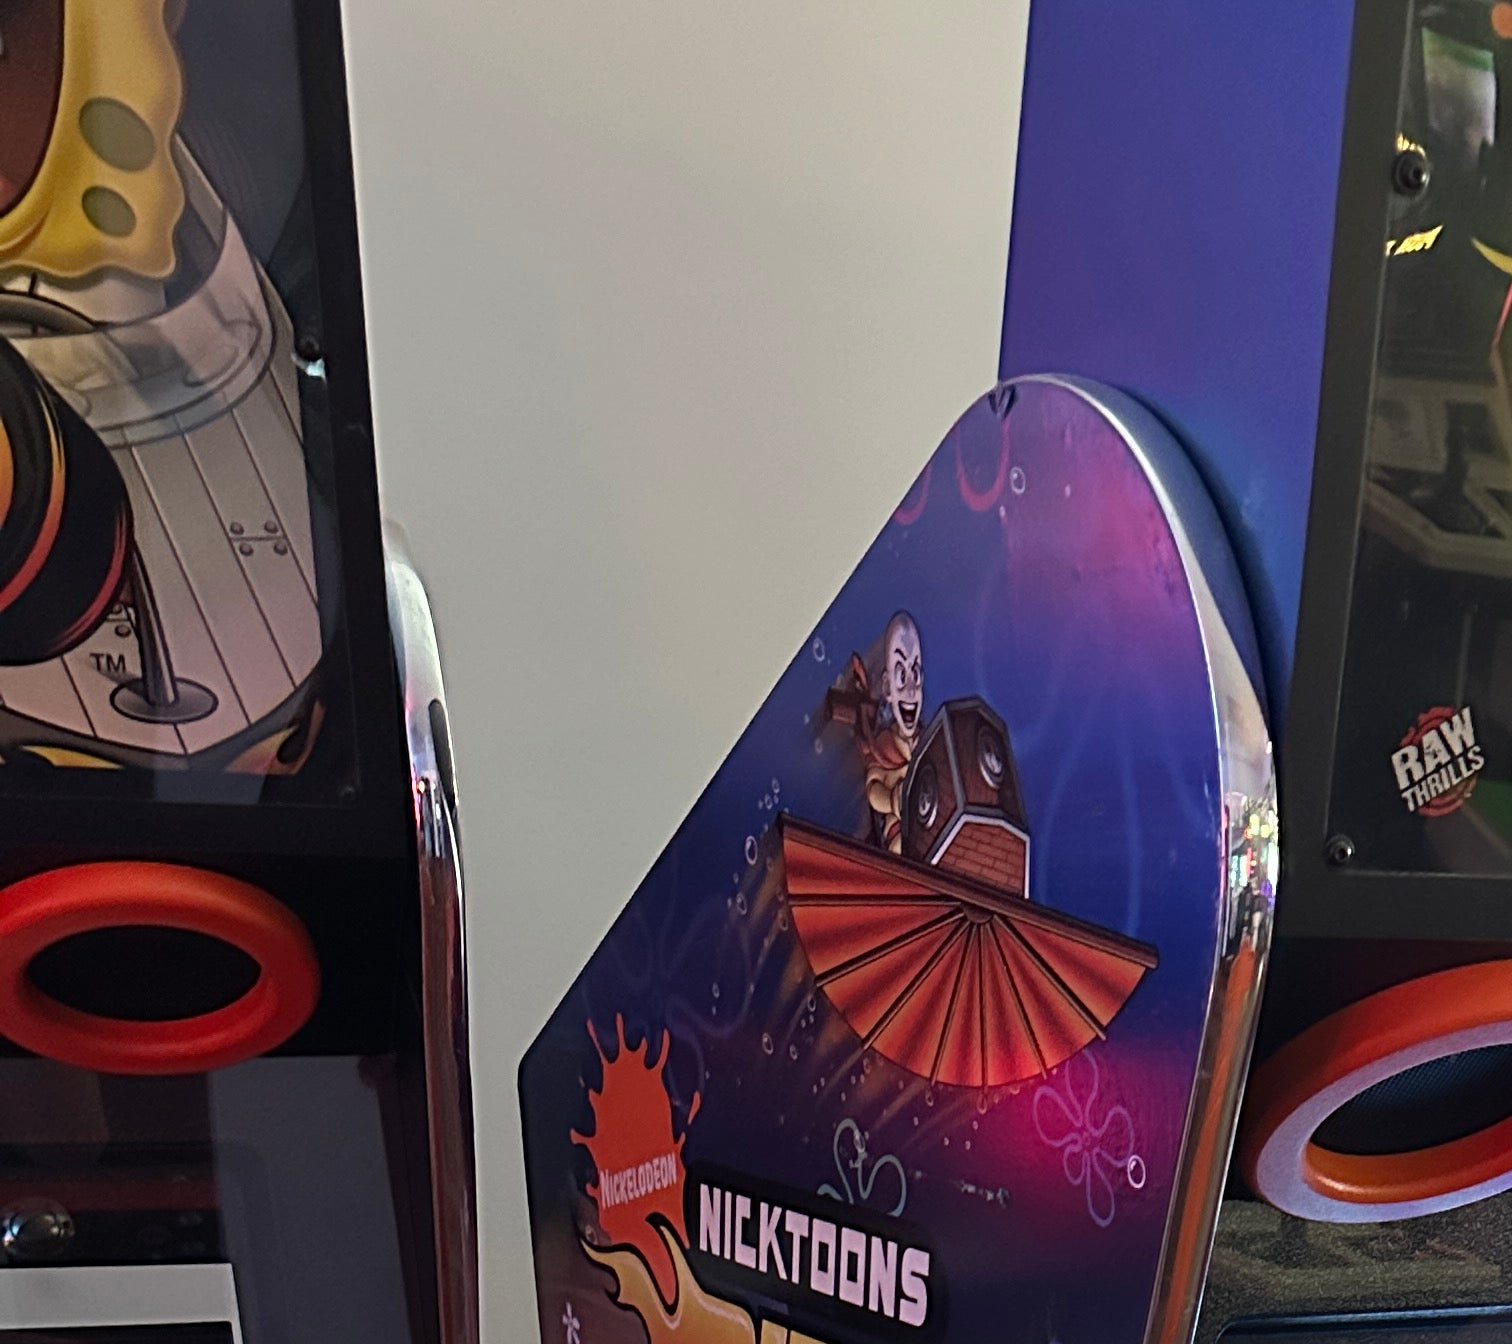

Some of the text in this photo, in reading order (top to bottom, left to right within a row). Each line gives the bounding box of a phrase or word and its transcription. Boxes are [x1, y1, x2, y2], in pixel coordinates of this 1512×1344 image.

[90, 653, 127, 675] TM
[1391, 706, 1477, 789] RAW
[1401, 745, 1485, 812] THRILLS
[600, 1151, 677, 1210] NICKELODEON
[700, 1184, 931, 1328] NICKTOONS
